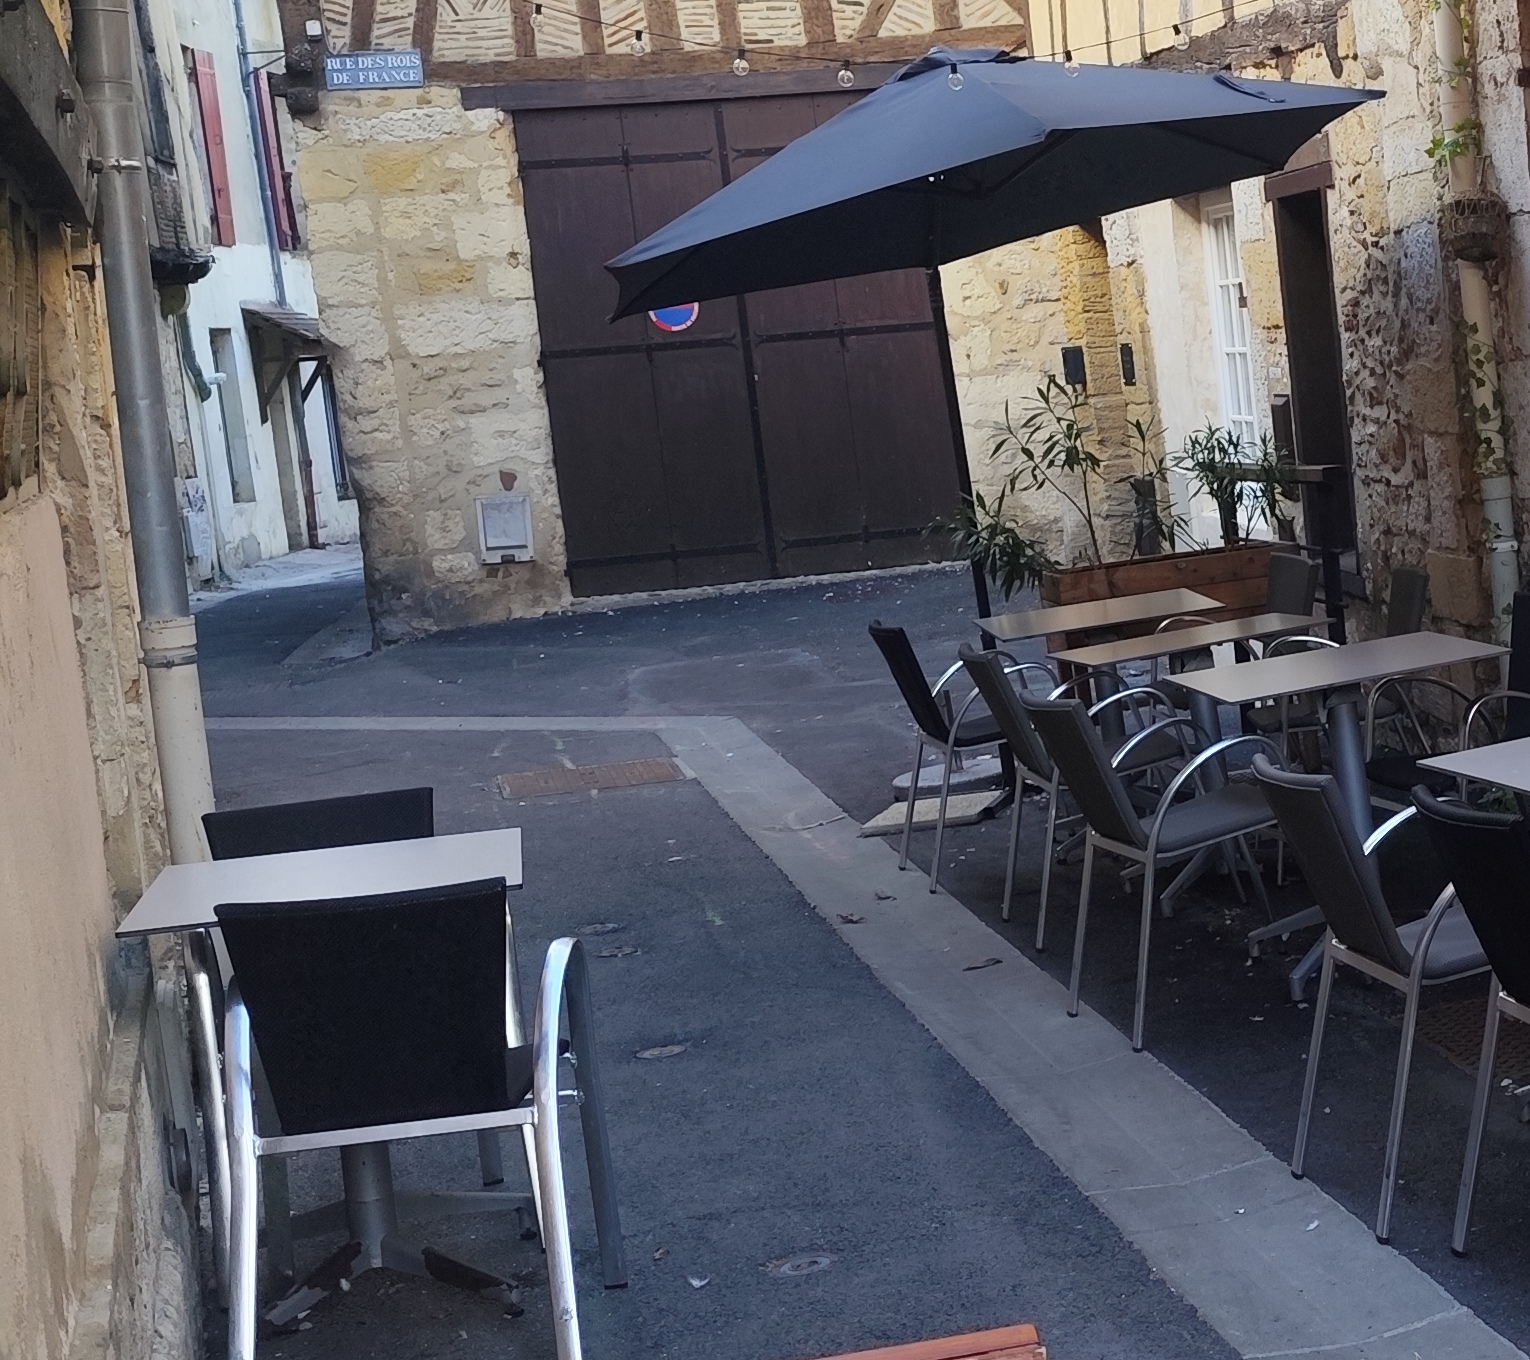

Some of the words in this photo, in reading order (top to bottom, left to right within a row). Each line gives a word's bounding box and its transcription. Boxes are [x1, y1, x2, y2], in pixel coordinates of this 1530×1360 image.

[327, 57, 355, 70] RUE
[358, 56, 385, 69] DES
[387, 54, 420, 68] ROIS
[332, 72, 352, 84] DE
[358, 70, 419, 83] FRANCE
